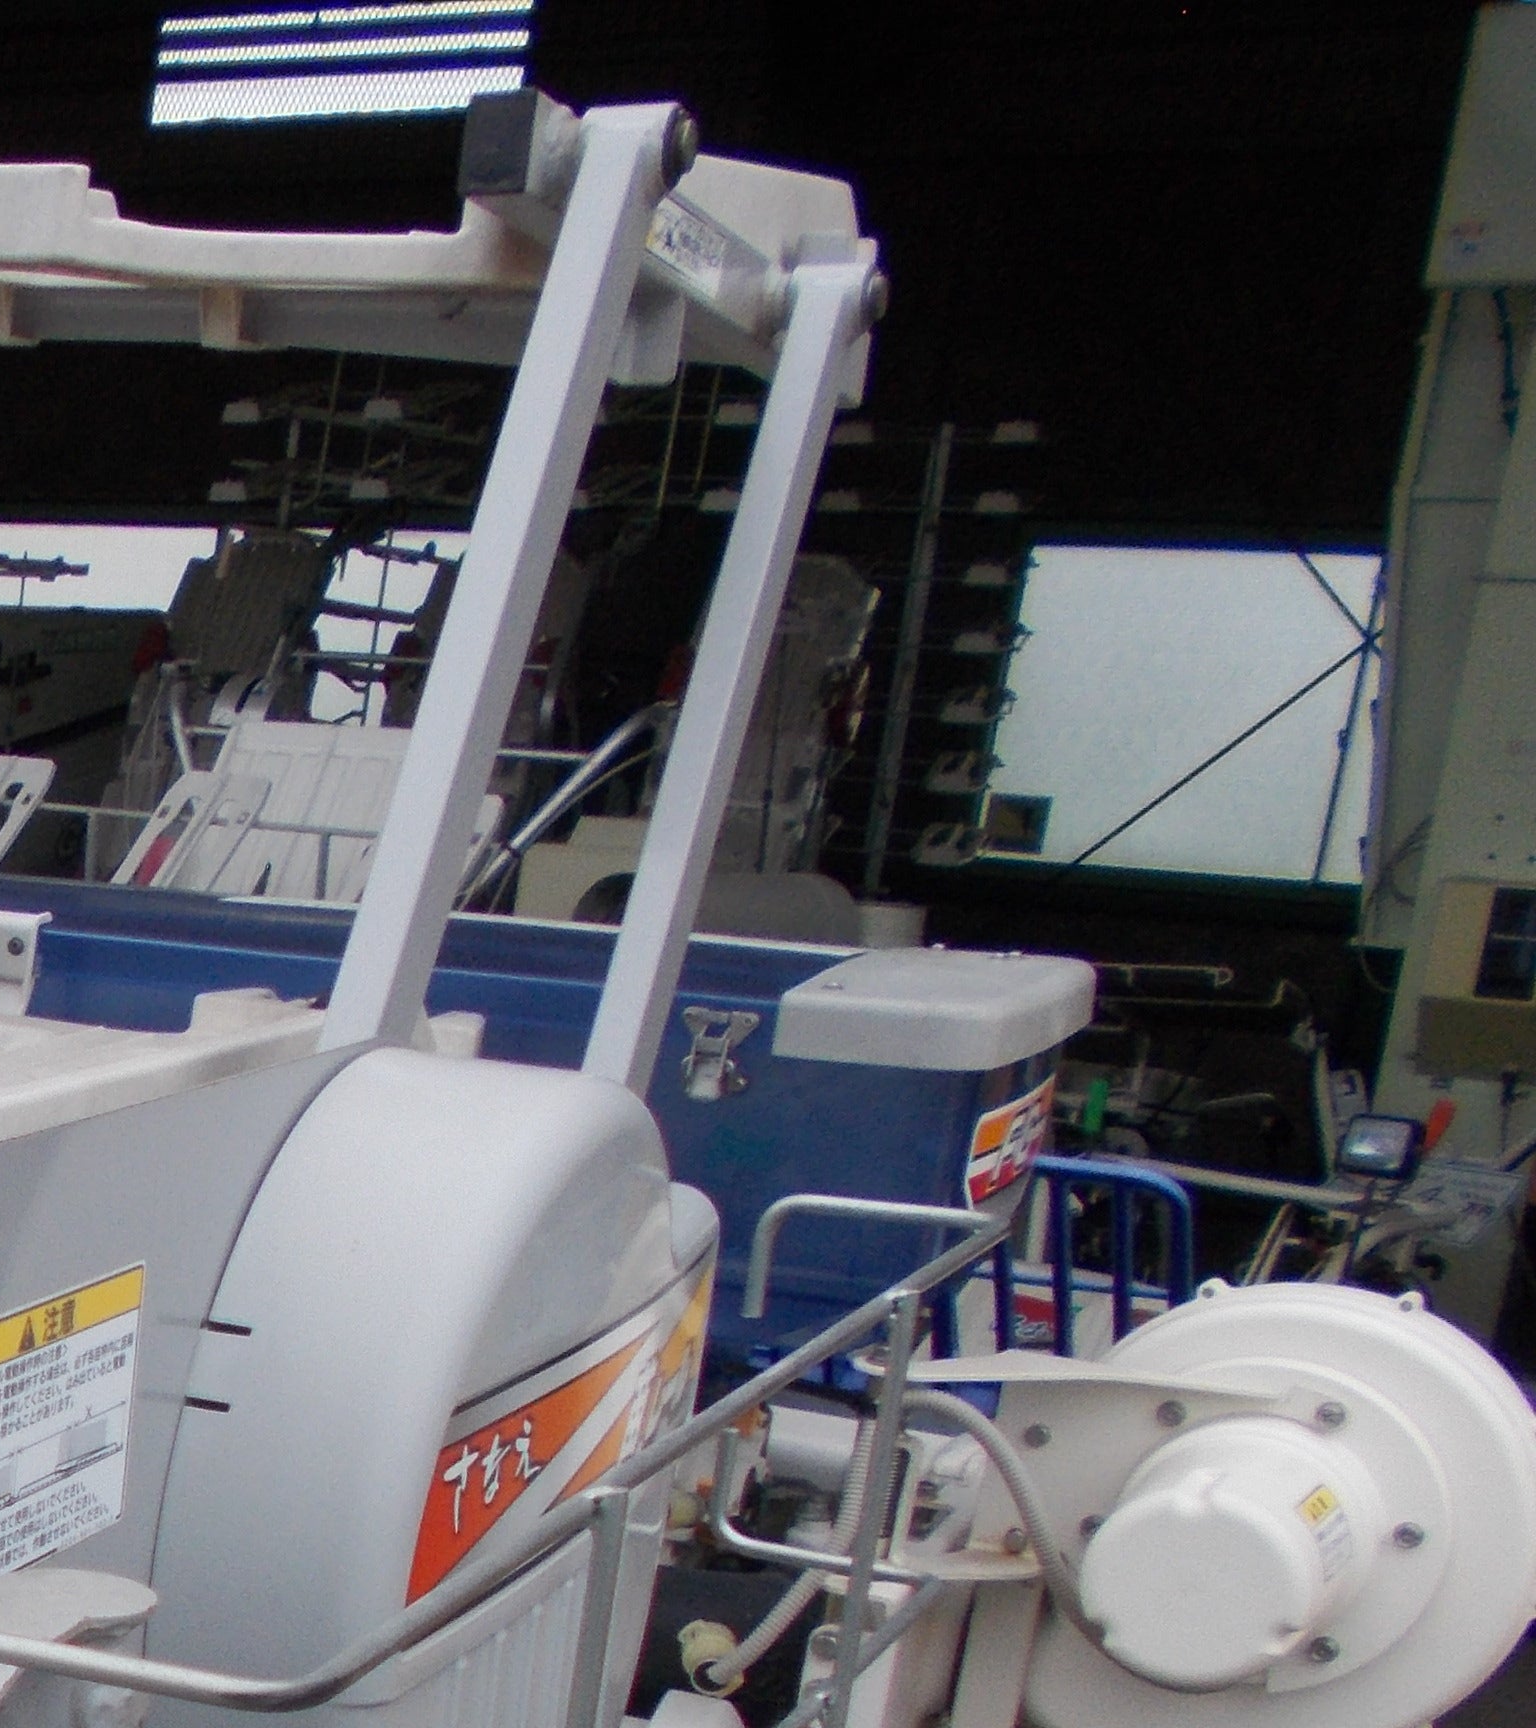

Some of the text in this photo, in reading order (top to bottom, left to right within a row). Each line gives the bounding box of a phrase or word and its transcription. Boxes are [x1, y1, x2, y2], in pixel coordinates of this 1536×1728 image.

[42, 1298, 76, 1342] 注意
[443, 1418, 542, 1536] さなえ
